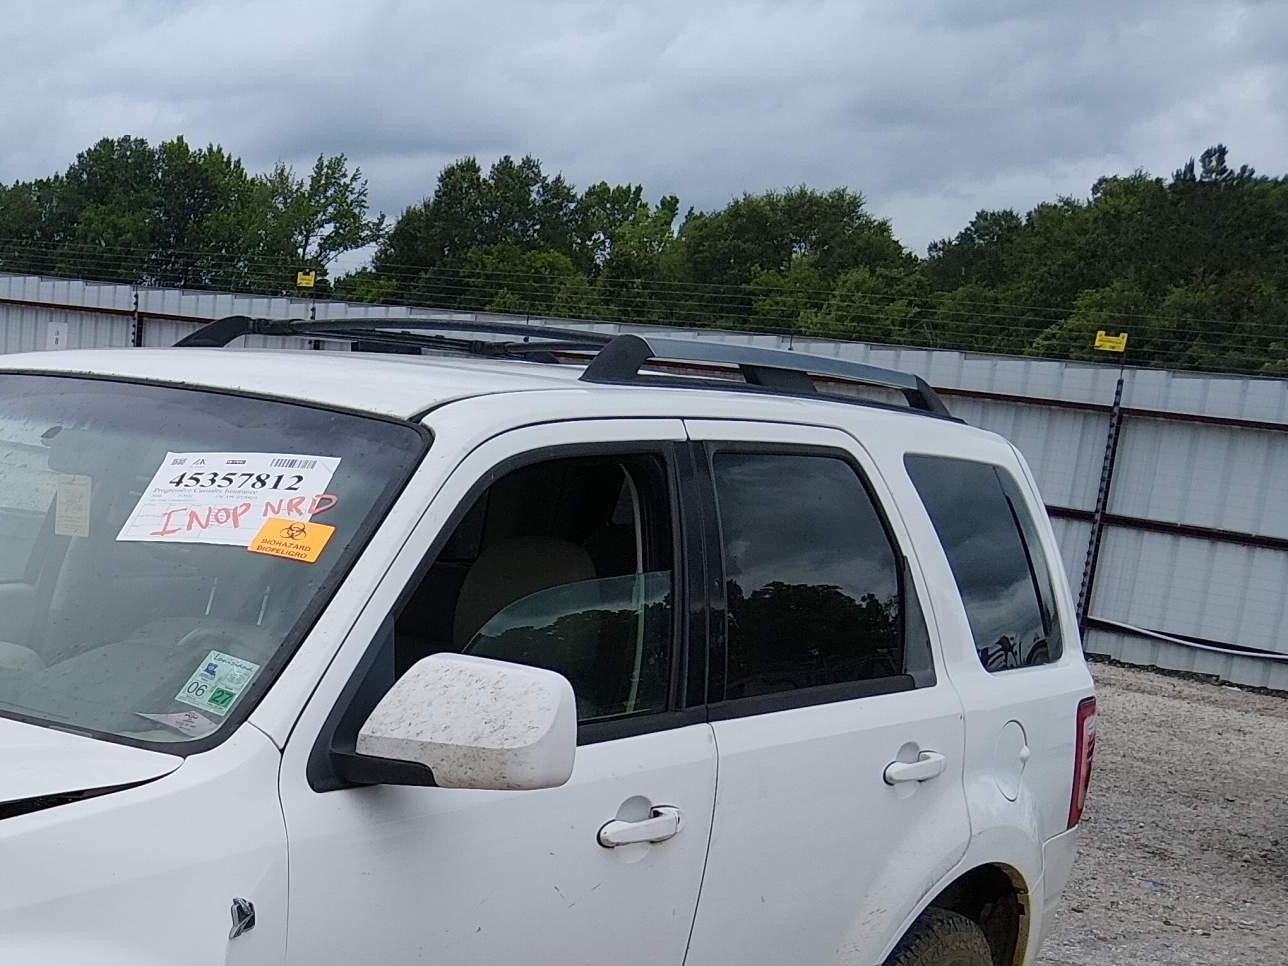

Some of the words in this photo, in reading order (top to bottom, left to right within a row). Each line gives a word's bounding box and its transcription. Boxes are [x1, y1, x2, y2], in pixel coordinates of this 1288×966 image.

[168, 471, 305, 492] 45357812
[150, 502, 252, 537] INOP
[263, 493, 339, 518] NRD
[256, 545, 308, 559] BIOPELIGRO
[261, 538, 312, 552] BIOHAZARD
[187, 681, 208, 698] 06
[212, 690, 233, 706] 27
